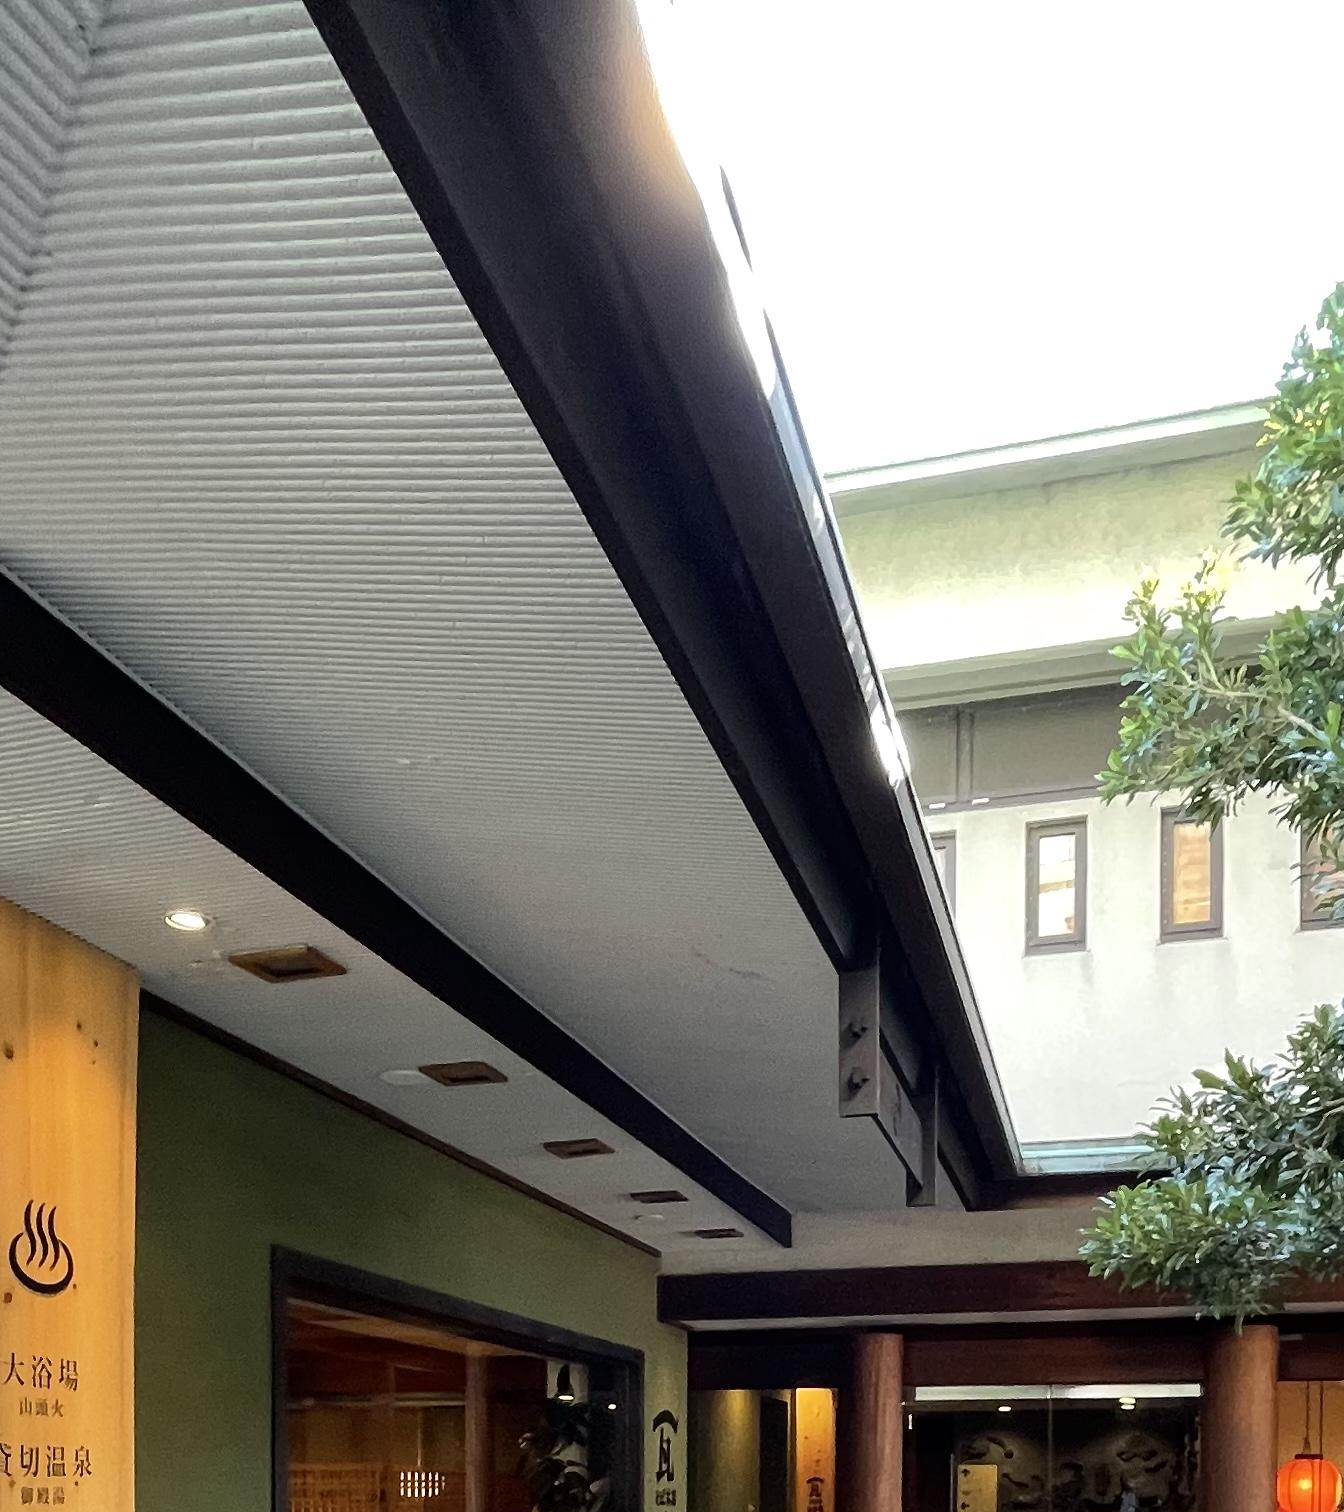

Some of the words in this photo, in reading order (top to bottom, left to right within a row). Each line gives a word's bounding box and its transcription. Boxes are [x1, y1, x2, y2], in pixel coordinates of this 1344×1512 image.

[3, 1352, 79, 1392] 大浴場
[19, 1396, 64, 1418] 山頭火
